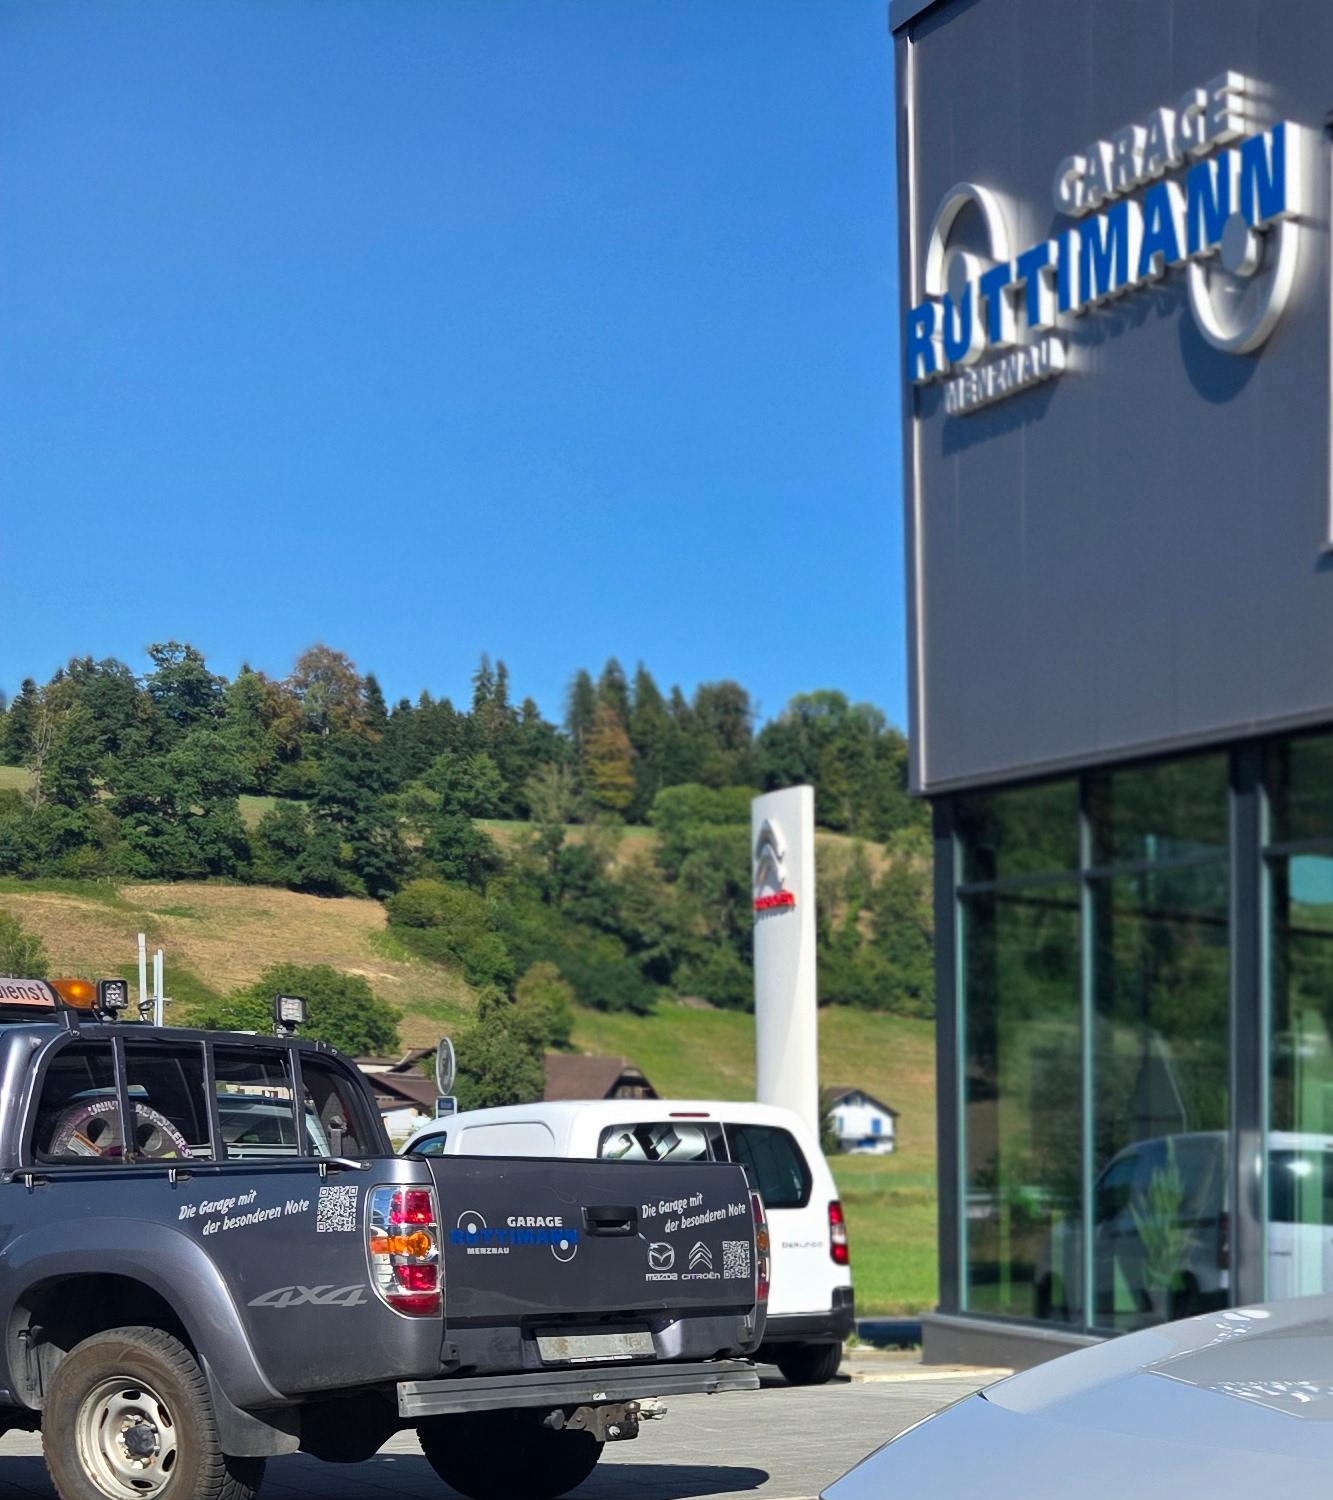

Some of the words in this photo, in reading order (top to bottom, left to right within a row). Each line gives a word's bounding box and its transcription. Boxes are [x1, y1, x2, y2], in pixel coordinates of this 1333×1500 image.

[1052, 70, 1246, 217] GARAGE
[0, 984, 49, 1001] ienst
[178, 1204, 196, 1220] Die
[199, 1197, 235, 1215] Garage
[237, 1189, 257, 1206] mit
[202, 1219, 221, 1236] der
[222, 1206, 282, 1231] besonderen
[284, 1199, 310, 1215] Note
[642, 1203, 656, 1219] Die
[658, 1197, 687, 1215] Garage
[689, 1192, 704, 1207] mit
[664, 1218, 679, 1233] der
[681, 1208, 726, 1229] besonderen
[728, 1202, 746, 1217] Note
[506, 1216, 563, 1228] GARAGE
